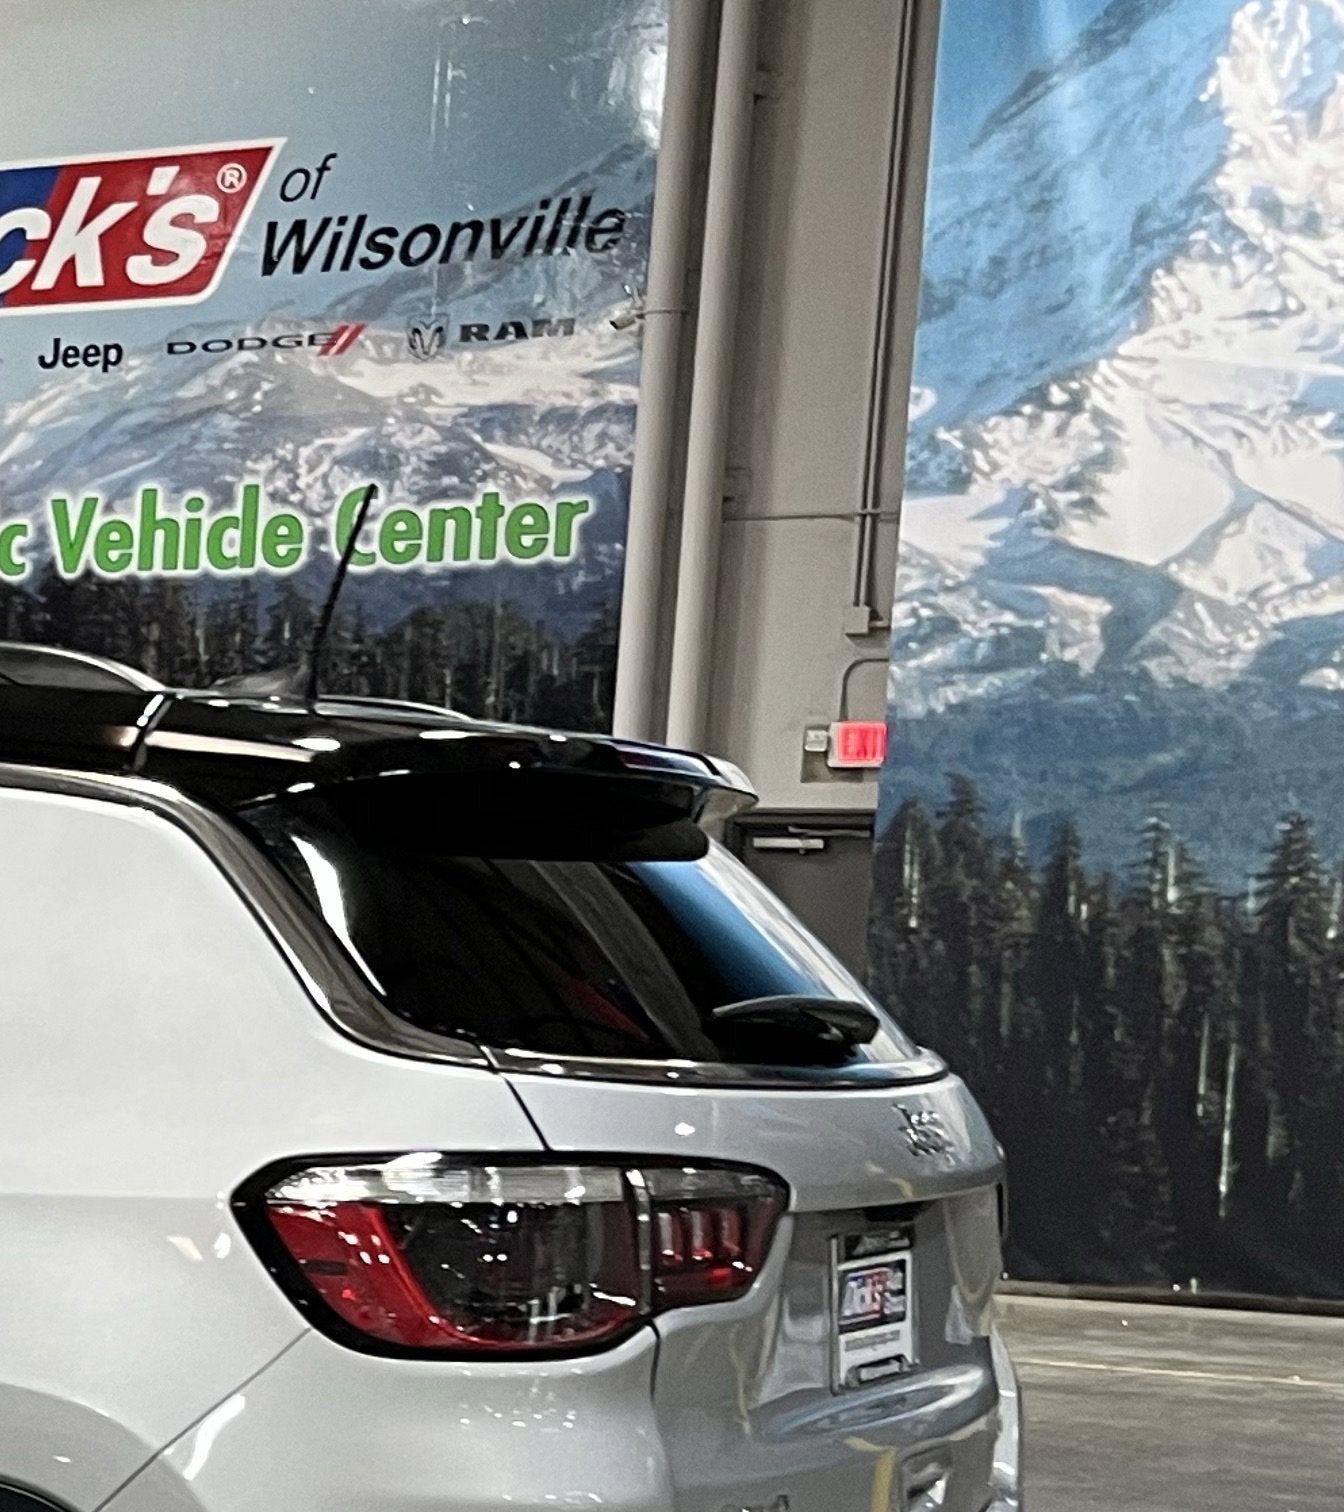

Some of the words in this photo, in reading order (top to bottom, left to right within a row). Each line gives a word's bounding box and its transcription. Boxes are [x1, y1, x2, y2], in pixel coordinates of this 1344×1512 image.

[279, 153, 338, 203] of
[261, 192, 626, 277] Wilsonville
[166, 331, 336, 356] DODGE
[458, 318, 575, 344] RAM
[38, 337, 124, 373] Jeep
[51, 484, 304, 574] Vehicle
[335, 484, 589, 566] Center
